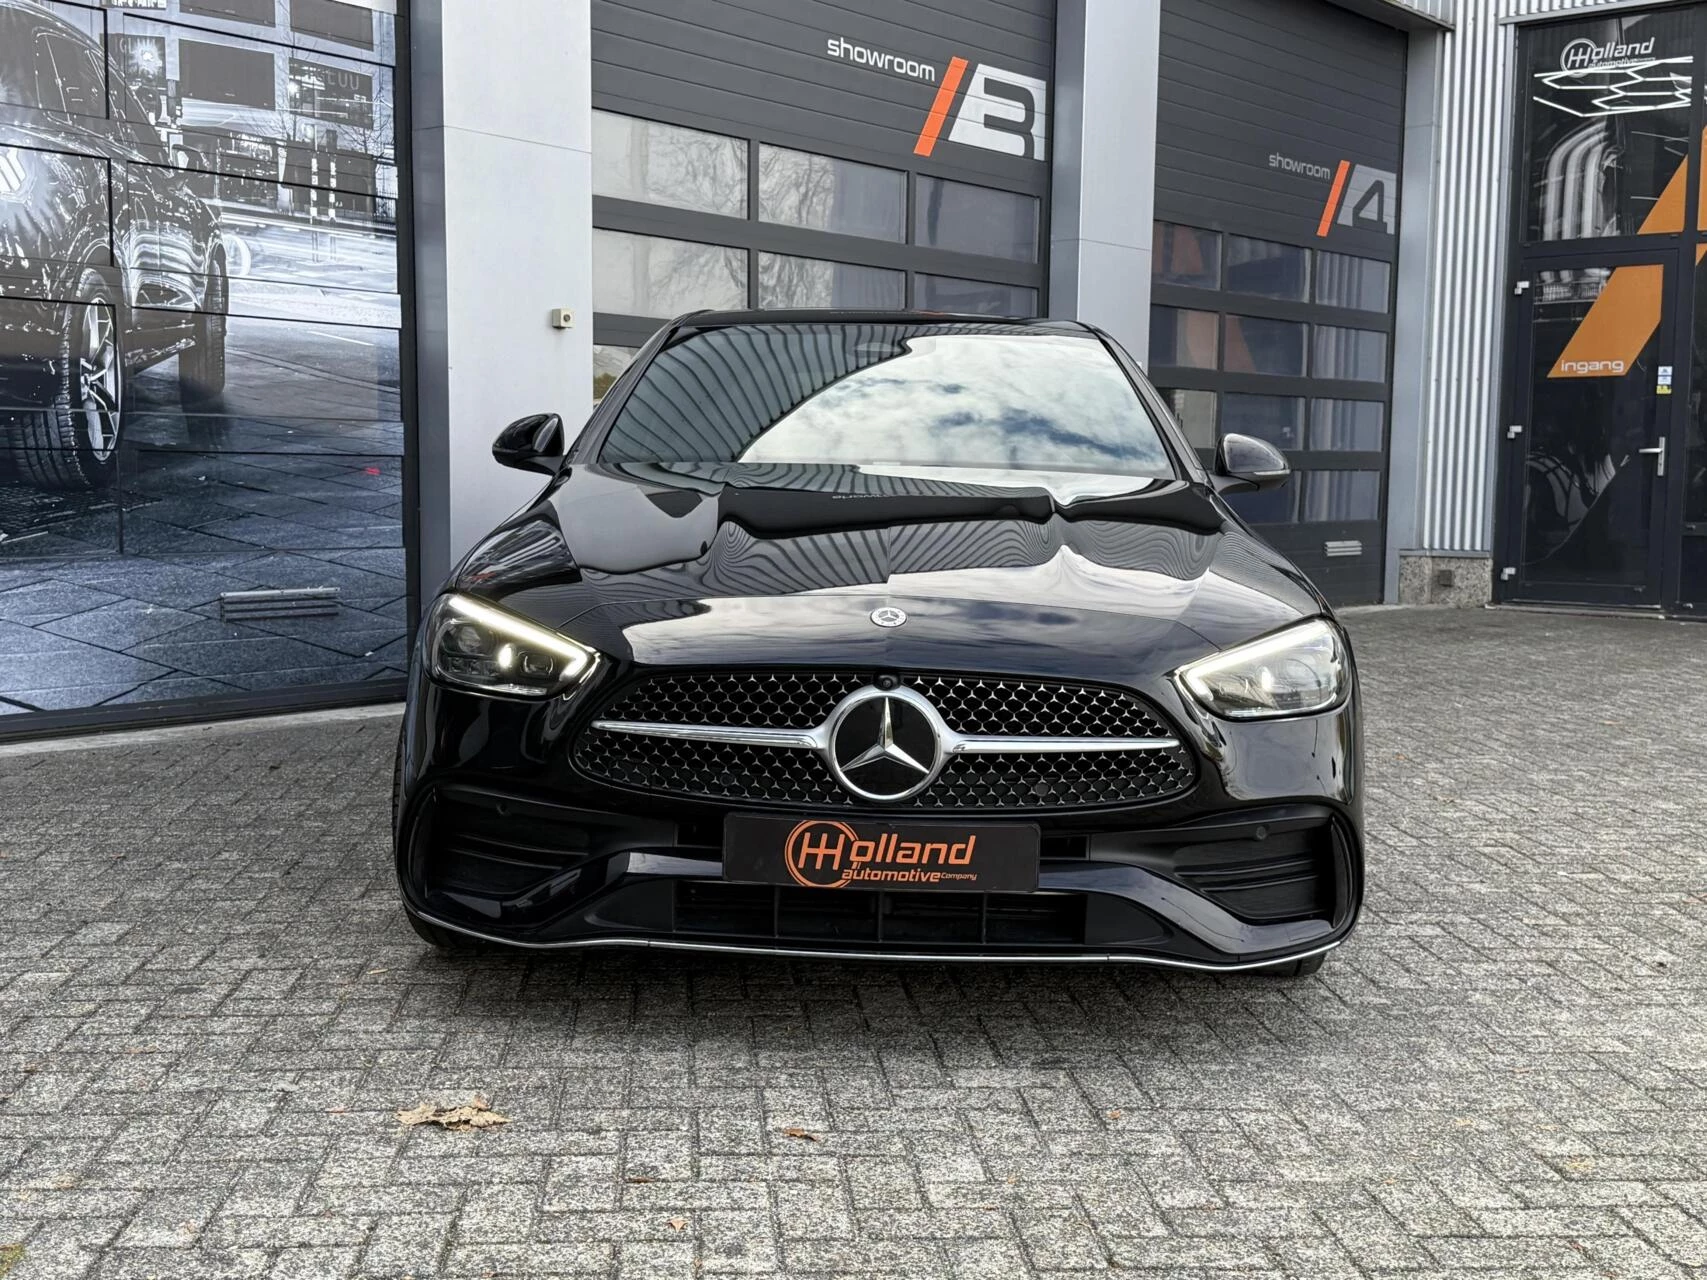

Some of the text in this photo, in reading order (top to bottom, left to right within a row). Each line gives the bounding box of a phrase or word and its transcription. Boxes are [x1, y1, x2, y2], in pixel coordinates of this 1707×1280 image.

[827, 37, 936, 82] showroom
[1268, 152, 1331, 181] showroom
[1560, 359, 1625, 374] ingang
[841, 866, 978, 883] automotive Company
